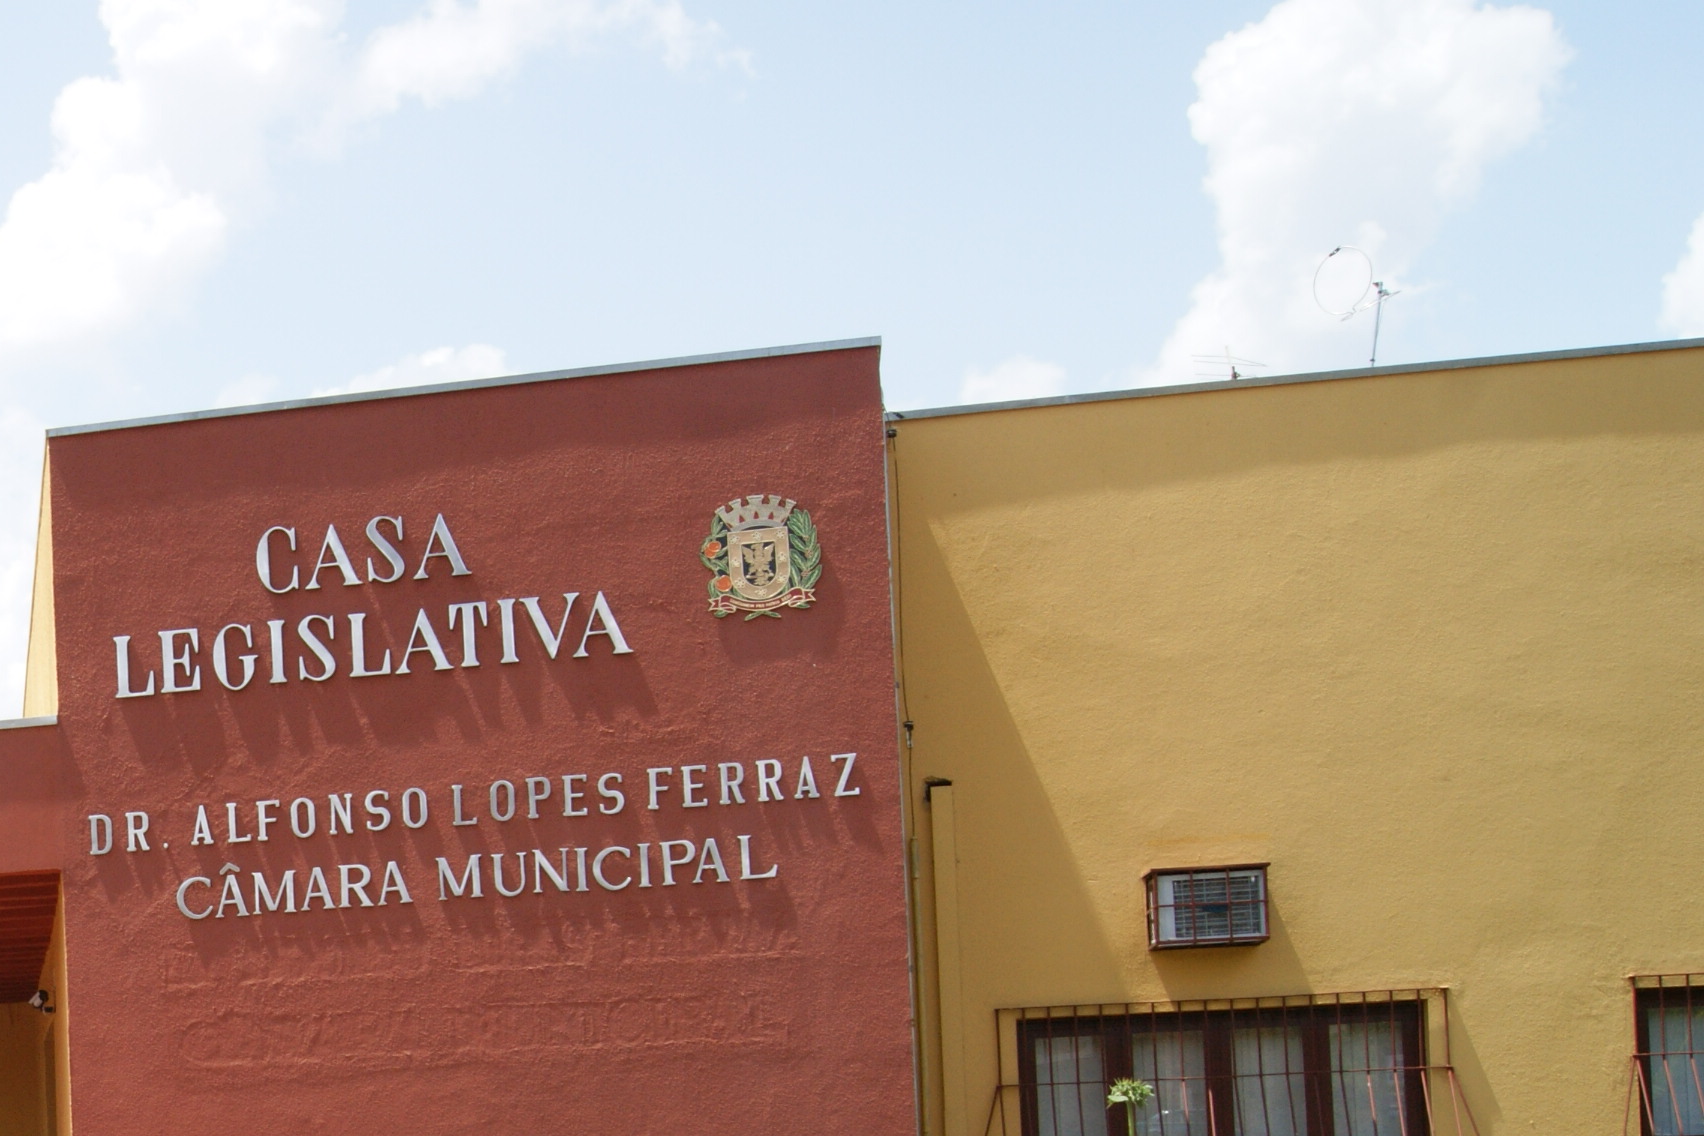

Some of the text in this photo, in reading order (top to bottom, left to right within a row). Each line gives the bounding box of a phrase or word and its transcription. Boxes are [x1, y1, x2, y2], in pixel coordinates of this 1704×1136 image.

[256, 513, 472, 594] CASA
[113, 590, 634, 699] LEGISLATIVA
[88, 752, 862, 855] DR. ALFONSO LOPES FERRAZ
[175, 834, 780, 921] CÂMARA MUNICIPAL
